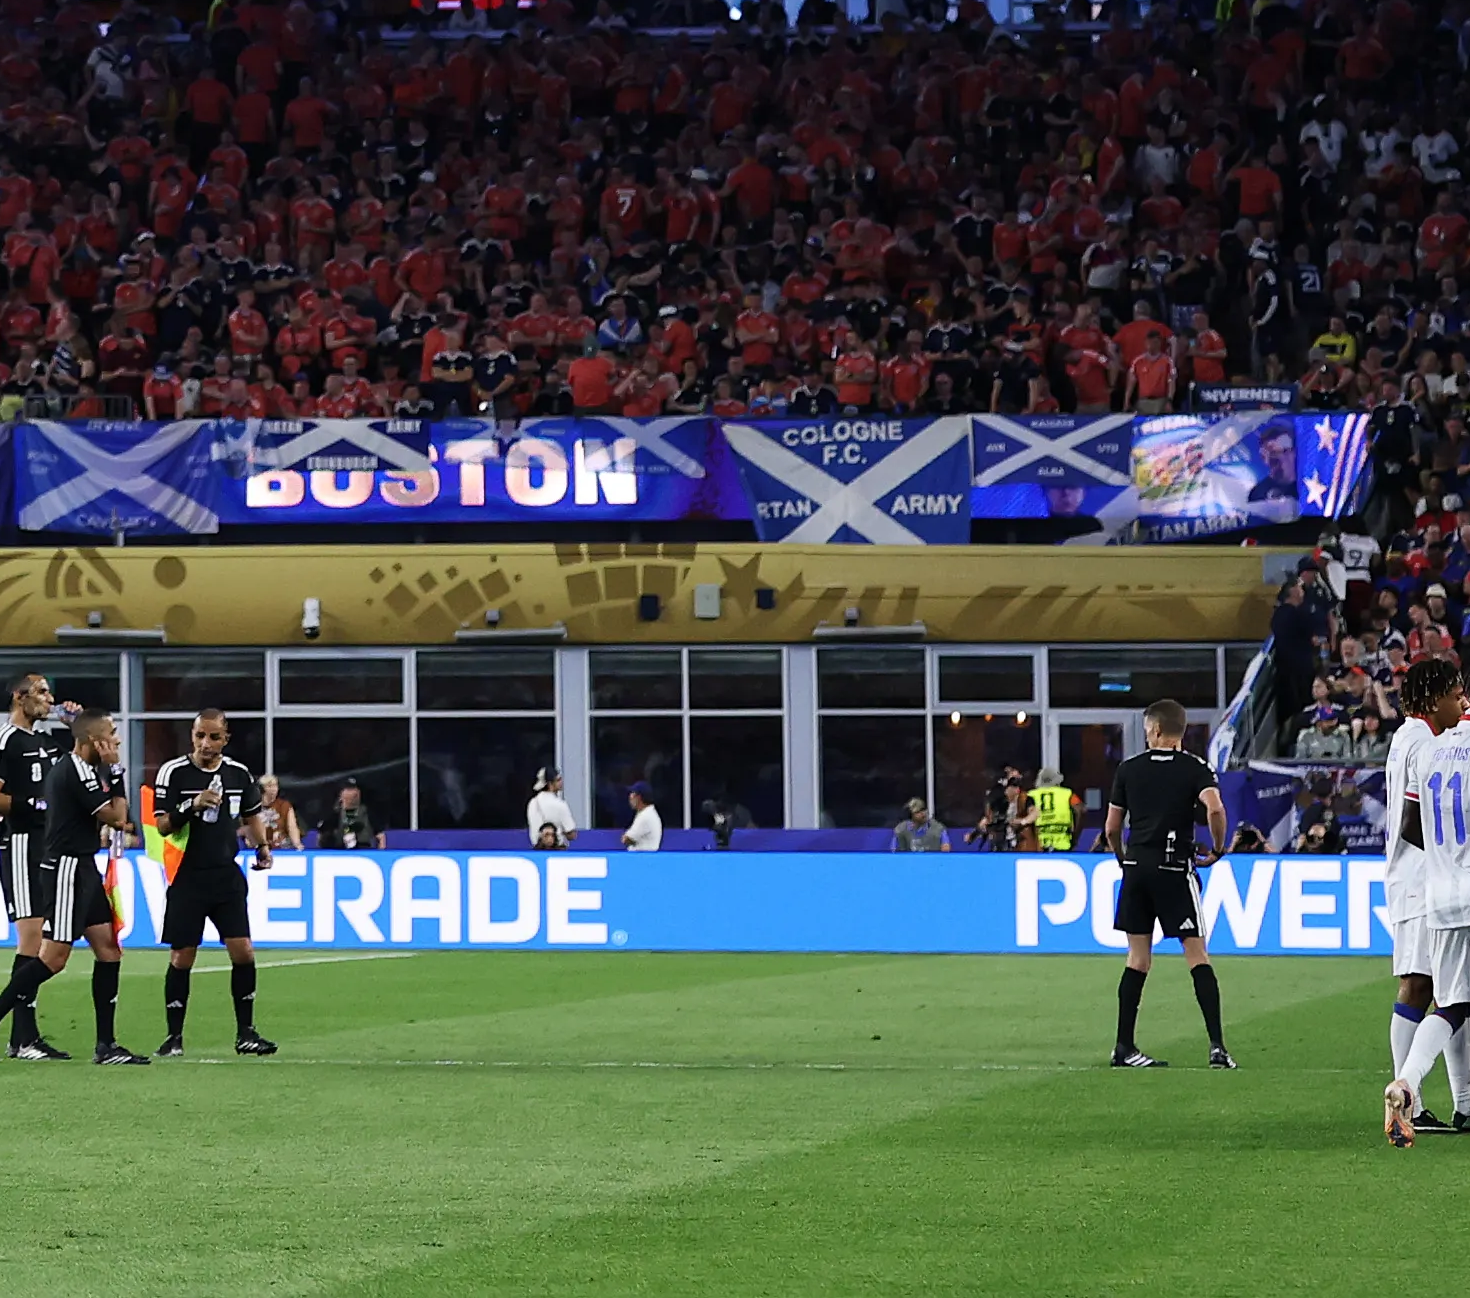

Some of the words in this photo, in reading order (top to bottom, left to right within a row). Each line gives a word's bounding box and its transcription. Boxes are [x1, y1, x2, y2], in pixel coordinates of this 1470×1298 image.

[1200, 387, 1292, 404] INVERNESS
[782, 420, 905, 447] COLOGNE
[821, 443, 868, 466] F.C.
[757, 499, 814, 520] RTAN
[890, 493, 963, 516] ARMY
[1193, 511, 1250, 536] ARMY
[1427, 771, 1466, 847] 11
